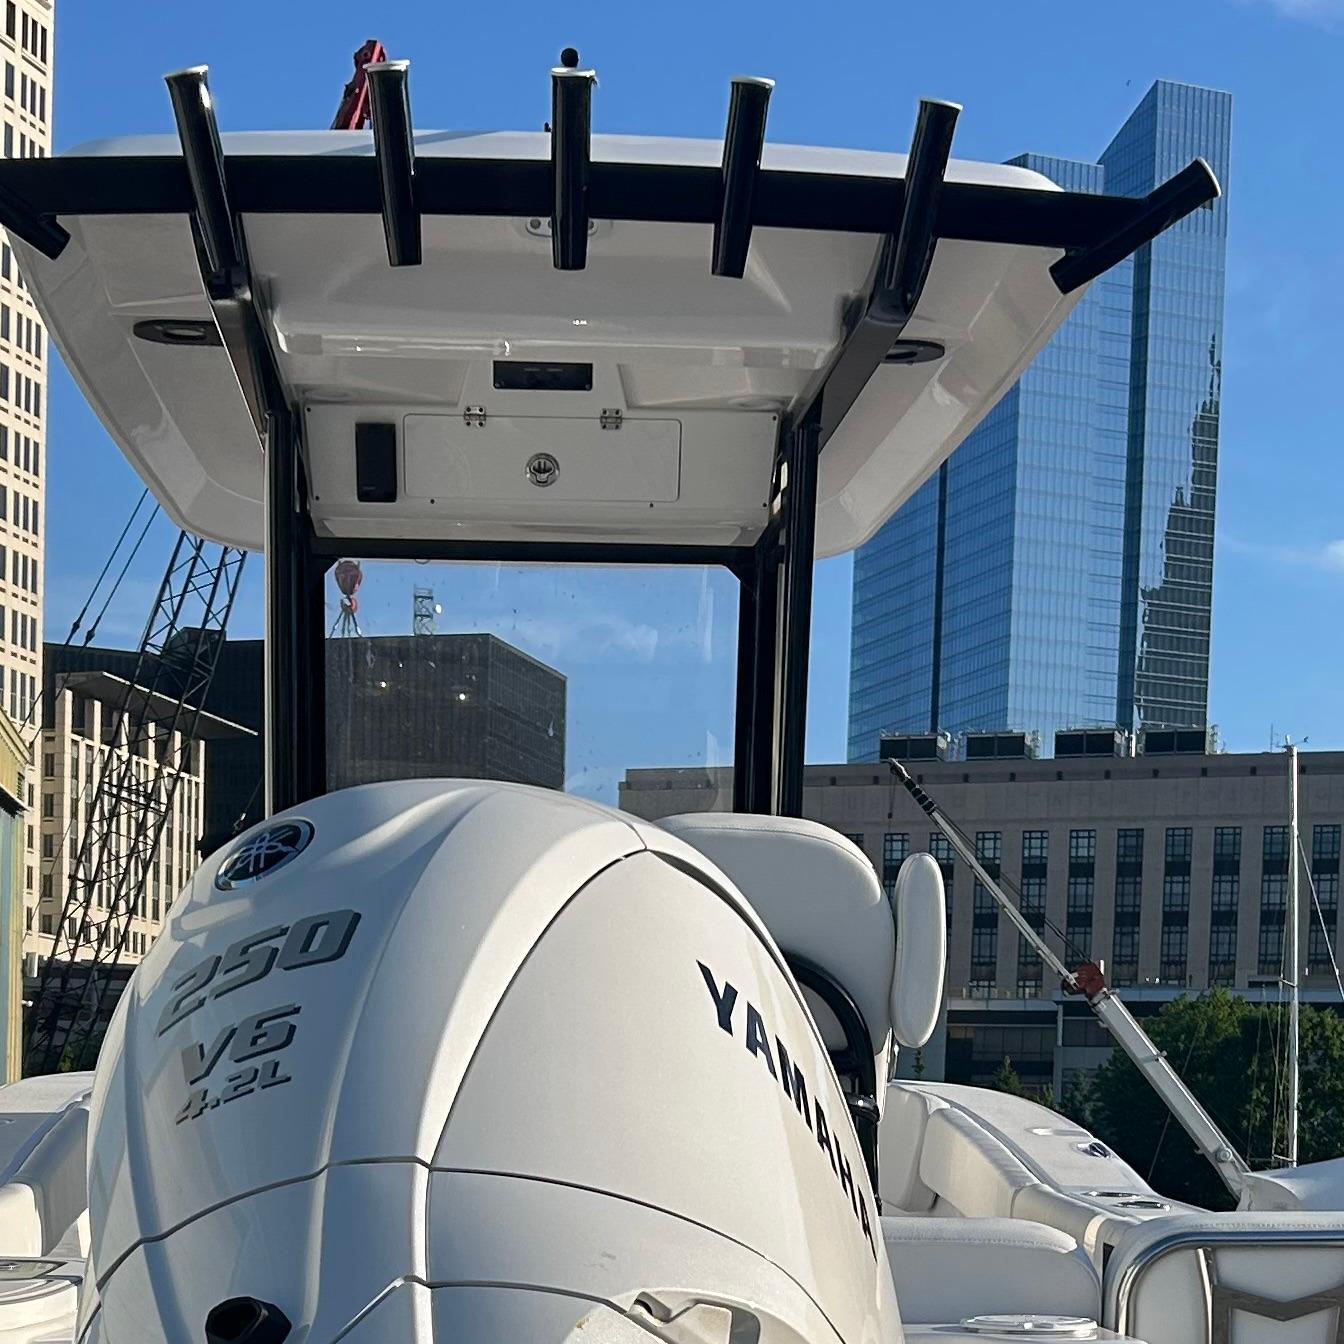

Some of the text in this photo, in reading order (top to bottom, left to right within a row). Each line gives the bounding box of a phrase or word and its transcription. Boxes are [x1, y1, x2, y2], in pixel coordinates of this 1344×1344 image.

[158, 909, 362, 1037] 250
[175, 1059, 292, 1126] 4.2L
[180, 1004, 301, 1084] V6
[696, 959, 878, 1263] YAMAHA
